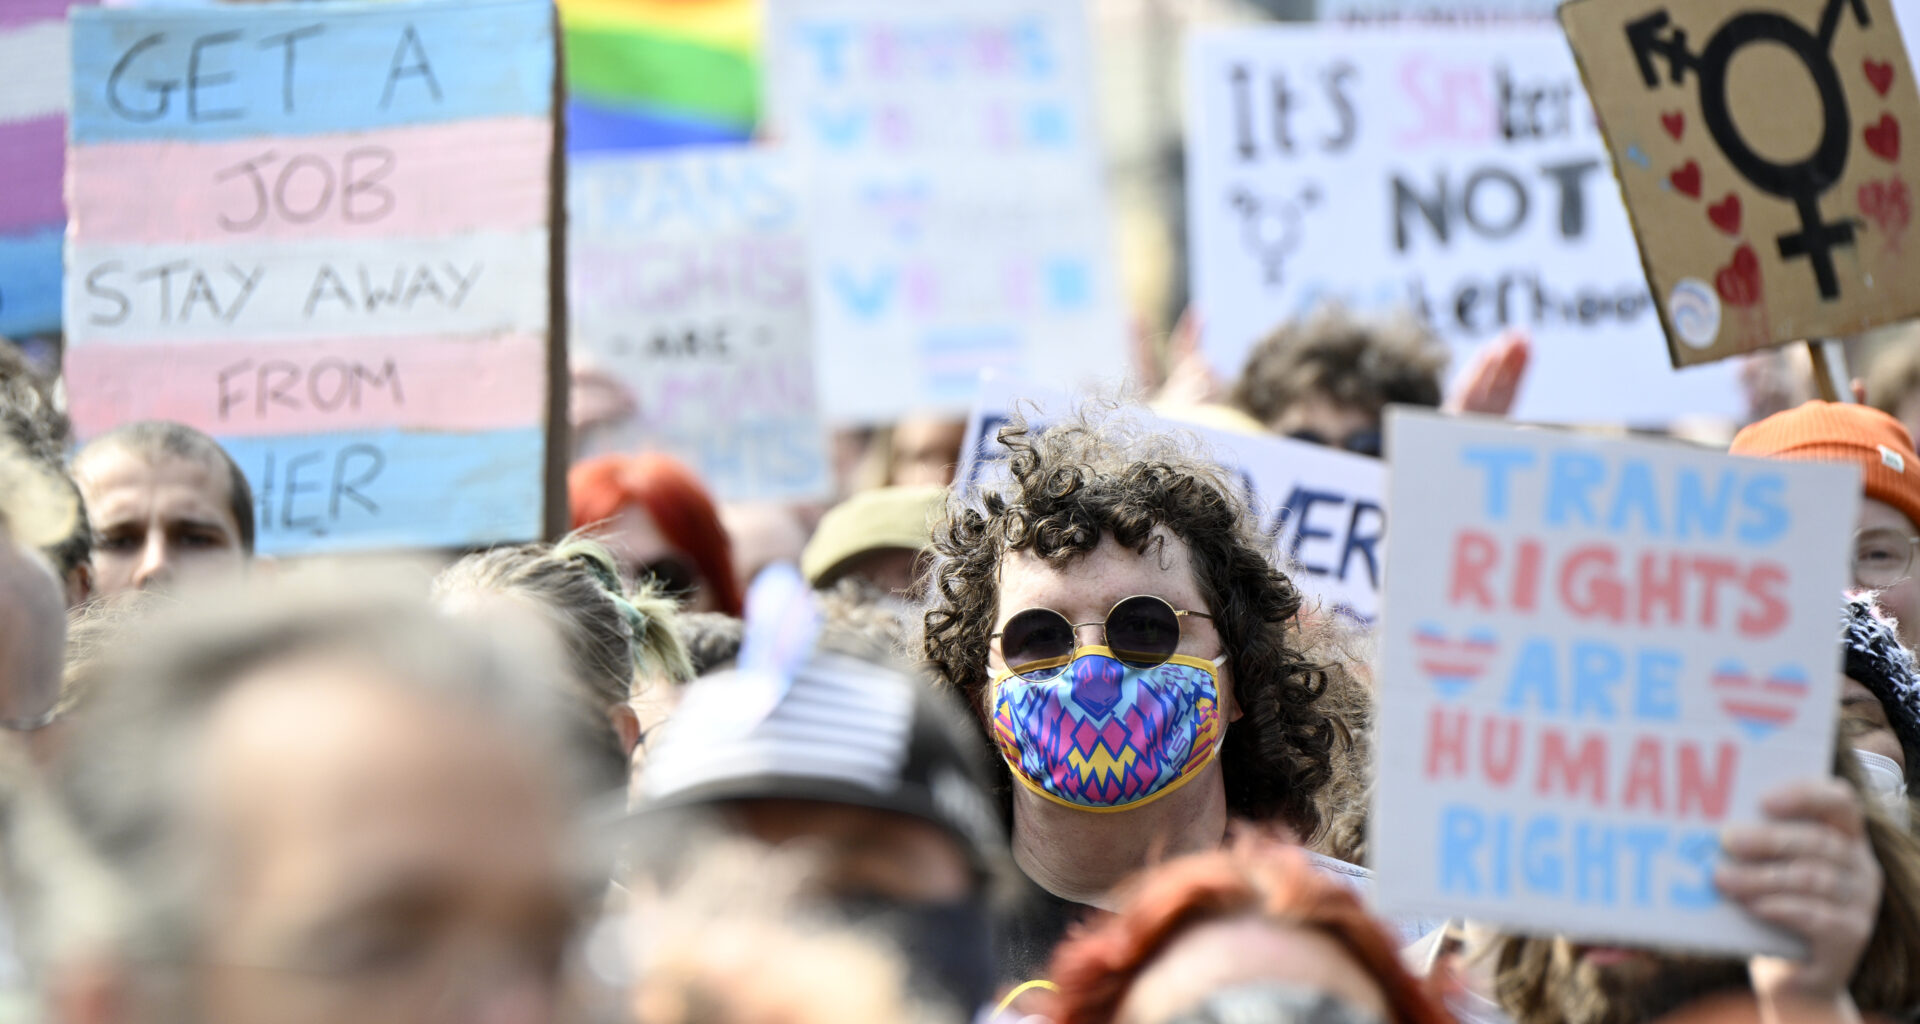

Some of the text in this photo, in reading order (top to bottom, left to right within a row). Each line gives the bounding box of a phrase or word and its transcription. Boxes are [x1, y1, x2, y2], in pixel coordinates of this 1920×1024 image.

[106, 22, 444, 123] GET A
[213, 145, 399, 234] JOB
[1389, 160, 1601, 254] NOT
[84, 259, 485, 328] STAY AWAY
[215, 355, 405, 421] FROM
[1461, 444, 1791, 544] TRANS
[1447, 528, 1792, 640] RIGHTS
[1507, 635, 1684, 722] ARE
[1424, 704, 1738, 822] HUMAN
[1439, 803, 1724, 912] RIGHTS
